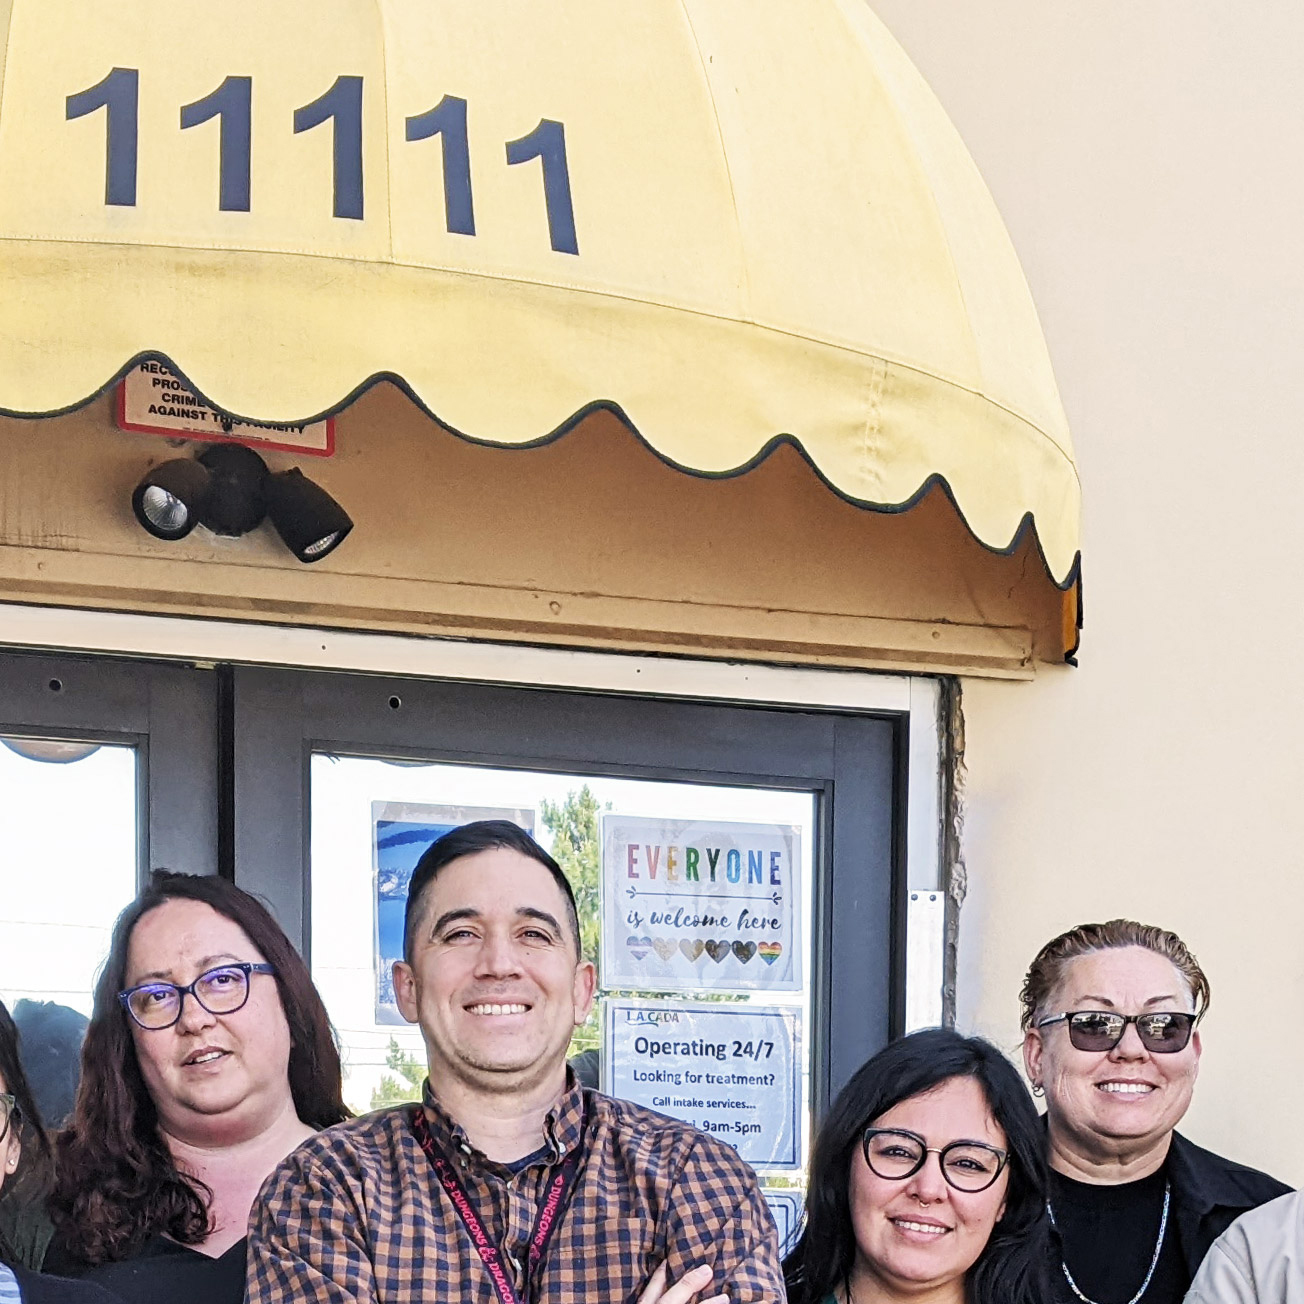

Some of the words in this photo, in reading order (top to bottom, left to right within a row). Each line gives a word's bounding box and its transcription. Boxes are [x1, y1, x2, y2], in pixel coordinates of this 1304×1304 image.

[65, 66, 580, 256] 11111
[148, 404, 208, 421] AGAINST
[627, 843, 782, 886] EVERYONE
[626, 909, 644, 929] is
[650, 906, 732, 929] welcome
[737, 908, 782, 931] here
[634, 1036, 727, 1061] Operating
[732, 1039, 775, 1062] 24/7
[633, 1069, 682, 1086] Looking
[684, 1070, 702, 1084] for
[705, 1072, 776, 1087] treatment?
[652, 1096, 671, 1107] Call
[673, 1096, 704, 1108] intake
[702, 1121, 762, 1136] 9am-5pm
[451, 1189, 489, 1249] DUNGEONS
[534, 1186, 564, 1247] DUNGEONS
